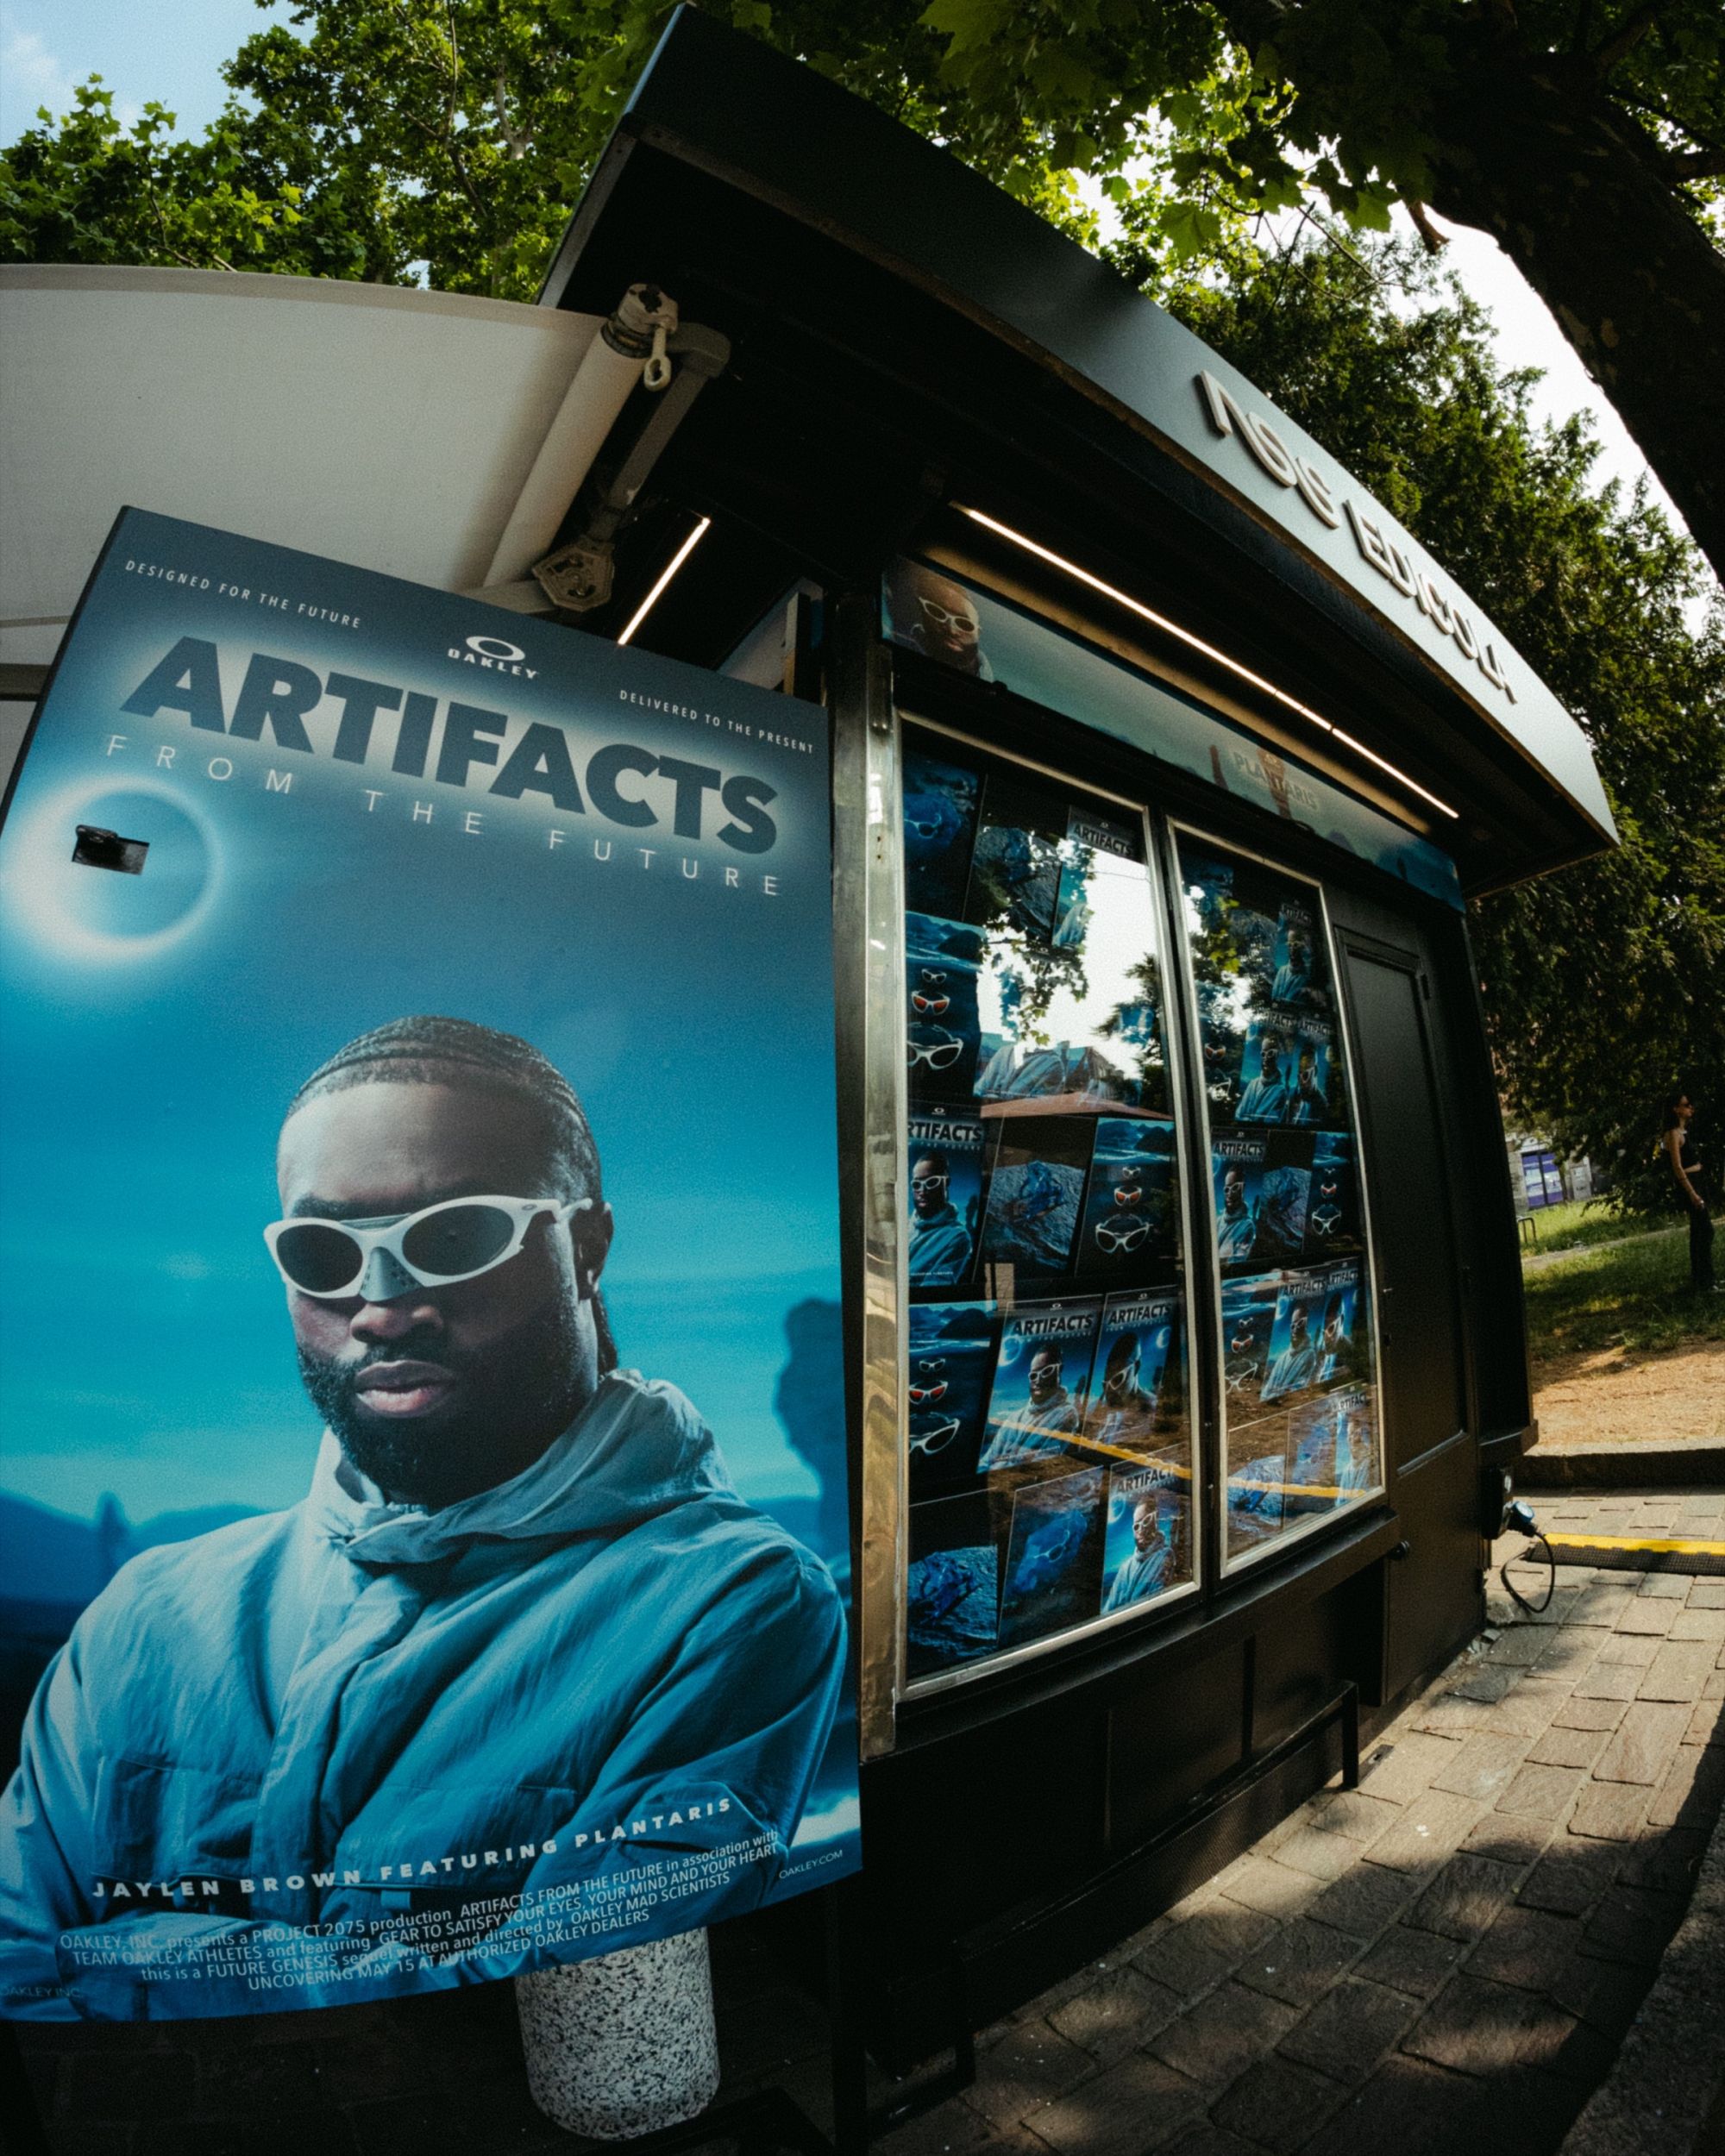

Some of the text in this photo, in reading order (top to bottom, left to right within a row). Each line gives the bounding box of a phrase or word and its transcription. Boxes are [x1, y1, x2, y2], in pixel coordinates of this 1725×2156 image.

[125, 560, 361, 628] DESIGNED FOR THE FUTURE
[448, 648, 537, 680] OAKLEY
[119, 636, 777, 854] ARTIFACTS
[620, 690, 813, 754] DELIVERED TO THE PRESENT
[106, 735, 779, 895] FROM THE FUTURE
[1074, 824, 1132, 857] ARTIFACTS
[908, 1121, 982, 1142] RTIFACTS
[1214, 1142, 1264, 1156] ARTIFACTS
[1013, 1315, 1093, 1336] ARTIFACTS
[1107, 1302, 1171, 1326] ARTIFACTS
[92, 1798, 731, 1897] JAYLEN BROWN FEATURING PLANTARIS
[779, 1850, 844, 1879] OAKLEY.COM
[60, 1934, 127, 1950] OAKLEY,
[166, 1932, 234, 1952] presents
[240, 1934, 248, 1944] a
[253, 1925, 320, 1943] PROJECT
[325, 1920, 365, 1937] 2075
[370, 1909, 451, 1935] production
[461, 1893, 534, 1918] ARTIFACTS
[538, 1883, 580, 1902] FROM
[583, 1875, 609, 1890] THE
[612, 1862, 662, 1884] FUTURE
[667, 1860, 678, 1873] in
[681, 1839, 749, 1868] association
[752, 1830, 778, 1847] with
[72, 1842, 778, 1965] TEAM OAKLEY ATHLETES and featuring GEAR TO SATISFY YOUR EYES, YOUR MIND AND YOUR HEART
[141, 1871, 731, 1980] this is a FUTURE GENESIS sequel written and directed by OAKLEY MAD SCIENTISTS
[248, 1908, 649, 1990] UNCOVERING MAY 15 AT AUTHORIZED OAKLEY DEALERS
